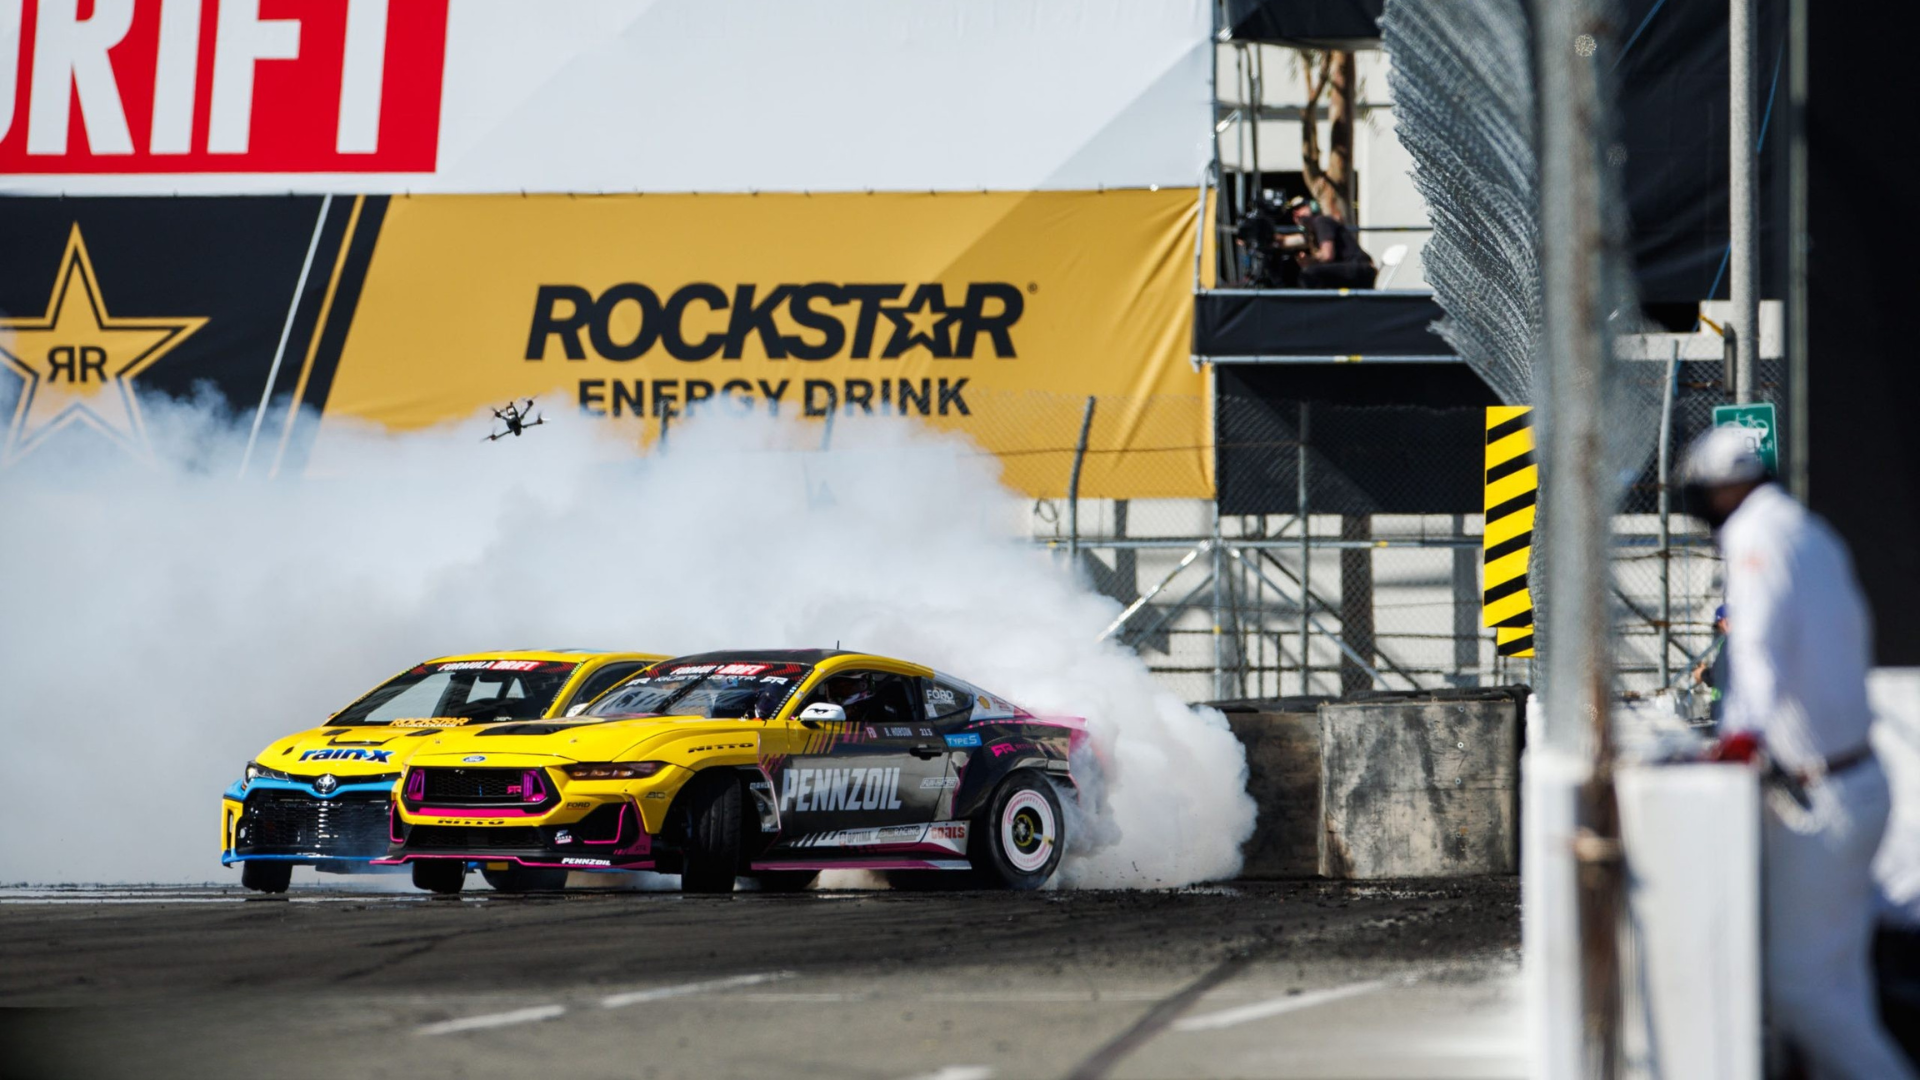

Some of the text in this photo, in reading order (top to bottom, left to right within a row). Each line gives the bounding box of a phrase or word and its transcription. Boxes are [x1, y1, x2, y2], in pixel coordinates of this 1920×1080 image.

[524, 282, 1025, 361] ROCKSTAR
[578, 377, 971, 418] ENERGY DRINK
[438, 660, 540, 672] FORMULA DRIFT
[926, 689, 954, 700] FORD
[389, 717, 470, 727] ROCKSTAR
[687, 742, 755, 753] NITTO
[780, 767, 902, 812] PENNZOIL
[561, 857, 611, 866] PENNZOIL
